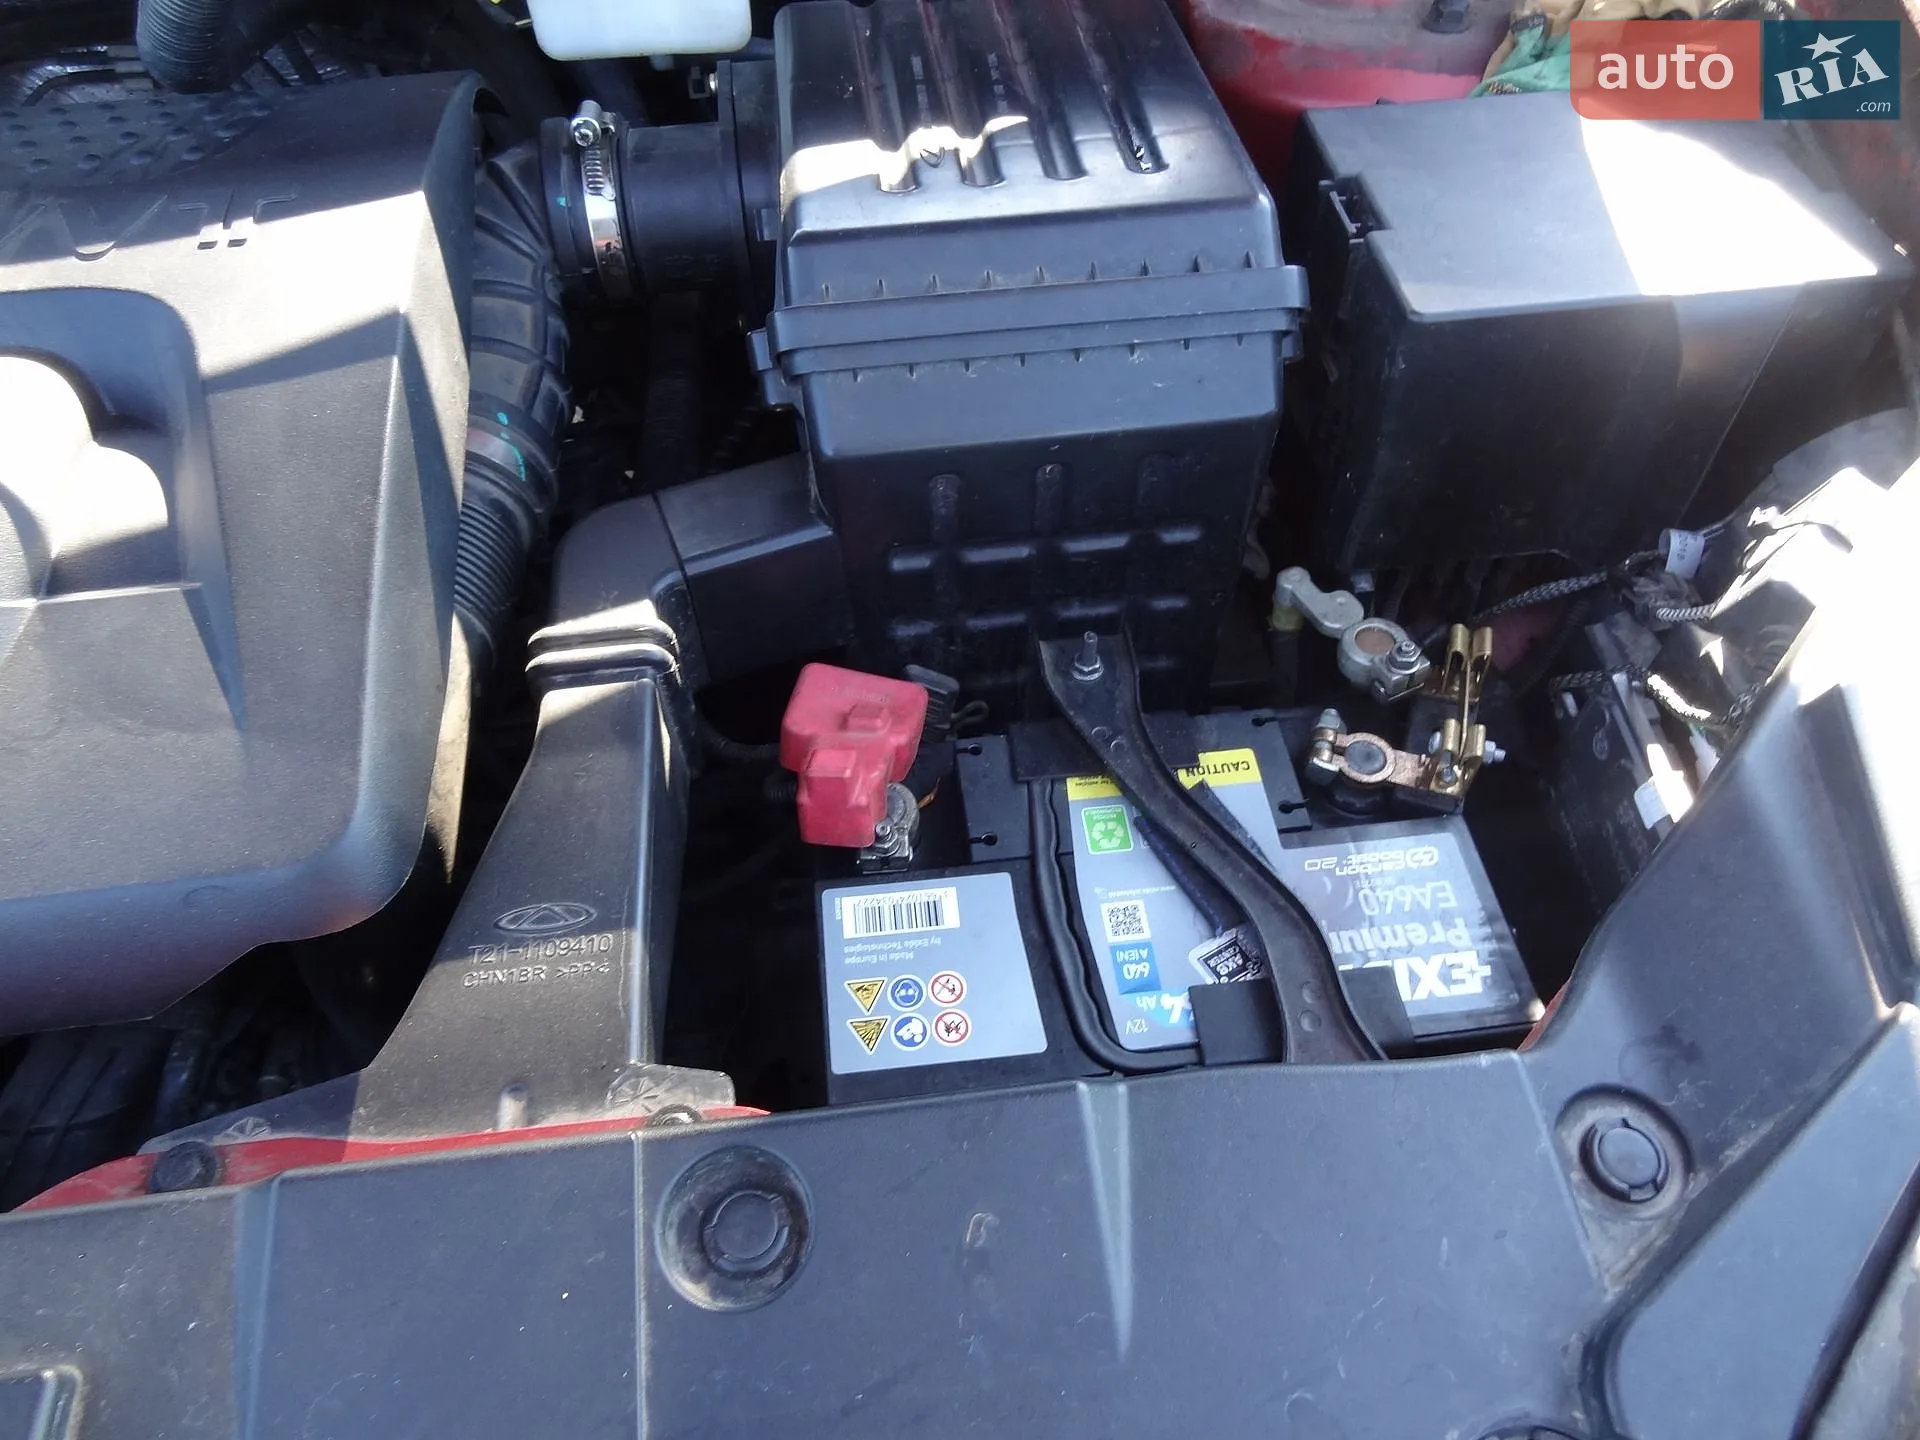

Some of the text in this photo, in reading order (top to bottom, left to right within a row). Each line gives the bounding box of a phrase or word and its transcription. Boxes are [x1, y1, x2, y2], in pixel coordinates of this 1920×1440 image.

[1186, 760, 1250, 777] CAUTION
[1335, 861, 1405, 876] carbon
[1358, 880, 1457, 916] EA640
[468, 933, 614, 966] T21-1109410
[844, 936, 941, 954] by Exide Technologies
[844, 954, 877, 964] Europe
[889, 951, 914, 961] Made
[1122, 962, 1150, 980] 640
[1136, 994, 1157, 1012] Ah
[1125, 1018, 1148, 1035] 12V
